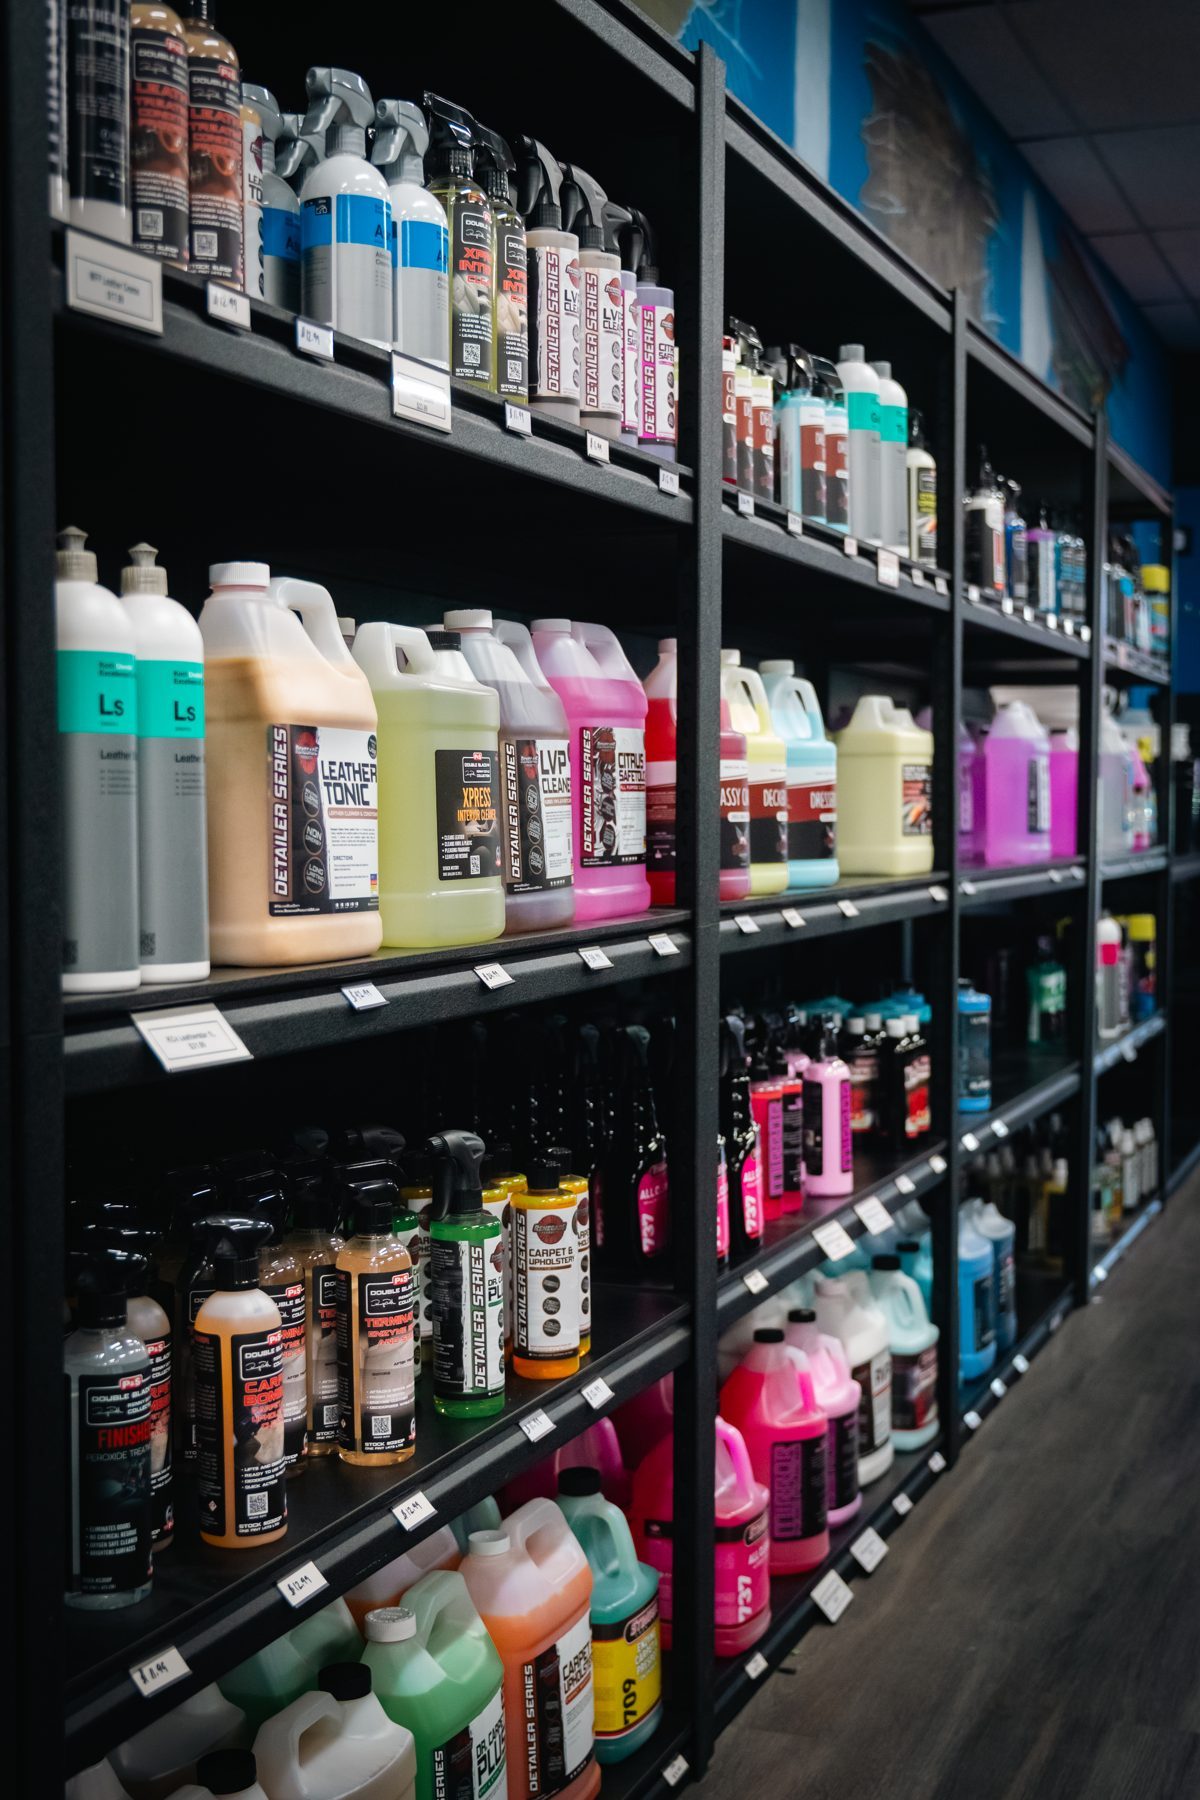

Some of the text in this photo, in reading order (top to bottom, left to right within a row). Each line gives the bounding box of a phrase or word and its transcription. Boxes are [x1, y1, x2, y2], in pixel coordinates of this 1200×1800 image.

[564, 289, 579, 302] LV
[546, 252, 561, 393] DETAILER SERIES
[585, 272, 599, 408] DETAILER SERIES
[644, 308, 657, 435] DETAILER SERIES
[99, 693, 124, 716] Ls
[173, 700, 196, 721] Ls
[321, 760, 377, 783] LEATHER
[540, 750, 567, 775] LVP
[618, 752, 644, 769] CITRUS
[323, 782, 370, 806] TONIC
[462, 787, 491, 808] XPRESS
[583, 729, 592, 853] DETAILER SERIES
[273, 727, 288, 896] DETAILER SERIES
[457, 809, 496, 821] INTERIOR CLEANER
[505, 742, 521, 879] DETAILER SERIES
[307, 826, 322, 840] NON
[308, 863, 324, 875] LONG
[744, 1195, 758, 1234] 737
[533, 1222, 567, 1232] RENEGADE
[641, 1213, 655, 1253] 737
[528, 1246, 573, 1257] CARPET &
[528, 1256, 575, 1266] UPHOLSTERY
[287, 1285, 302, 1297] P&S
[394, 1275, 409, 1285] P&S
[516, 1212, 527, 1347] DETAILER SERIES
[470, 1246, 486, 1388] DETAILER SERIES
[367, 1328, 405, 1338] ENZYME
[244, 1348, 275, 1359] DOUBLE
[121, 1376, 142, 1389] P&S
[91, 1393, 130, 1402] DOUBLE
[86, 1450, 128, 1462] PEROXIDE
[400, 1500, 422, 1519] $12.99
[97, 1532, 119, 1540] CHEMICAL
[287, 1574, 313, 1597] $12.99
[737, 1575, 752, 1623] 737
[562, 1642, 592, 1678] CARPET
[622, 1678, 637, 1725] 709
[524, 1664, 539, 1793] DETAILER SERIES
[434, 1750, 446, 1800] ERIES
